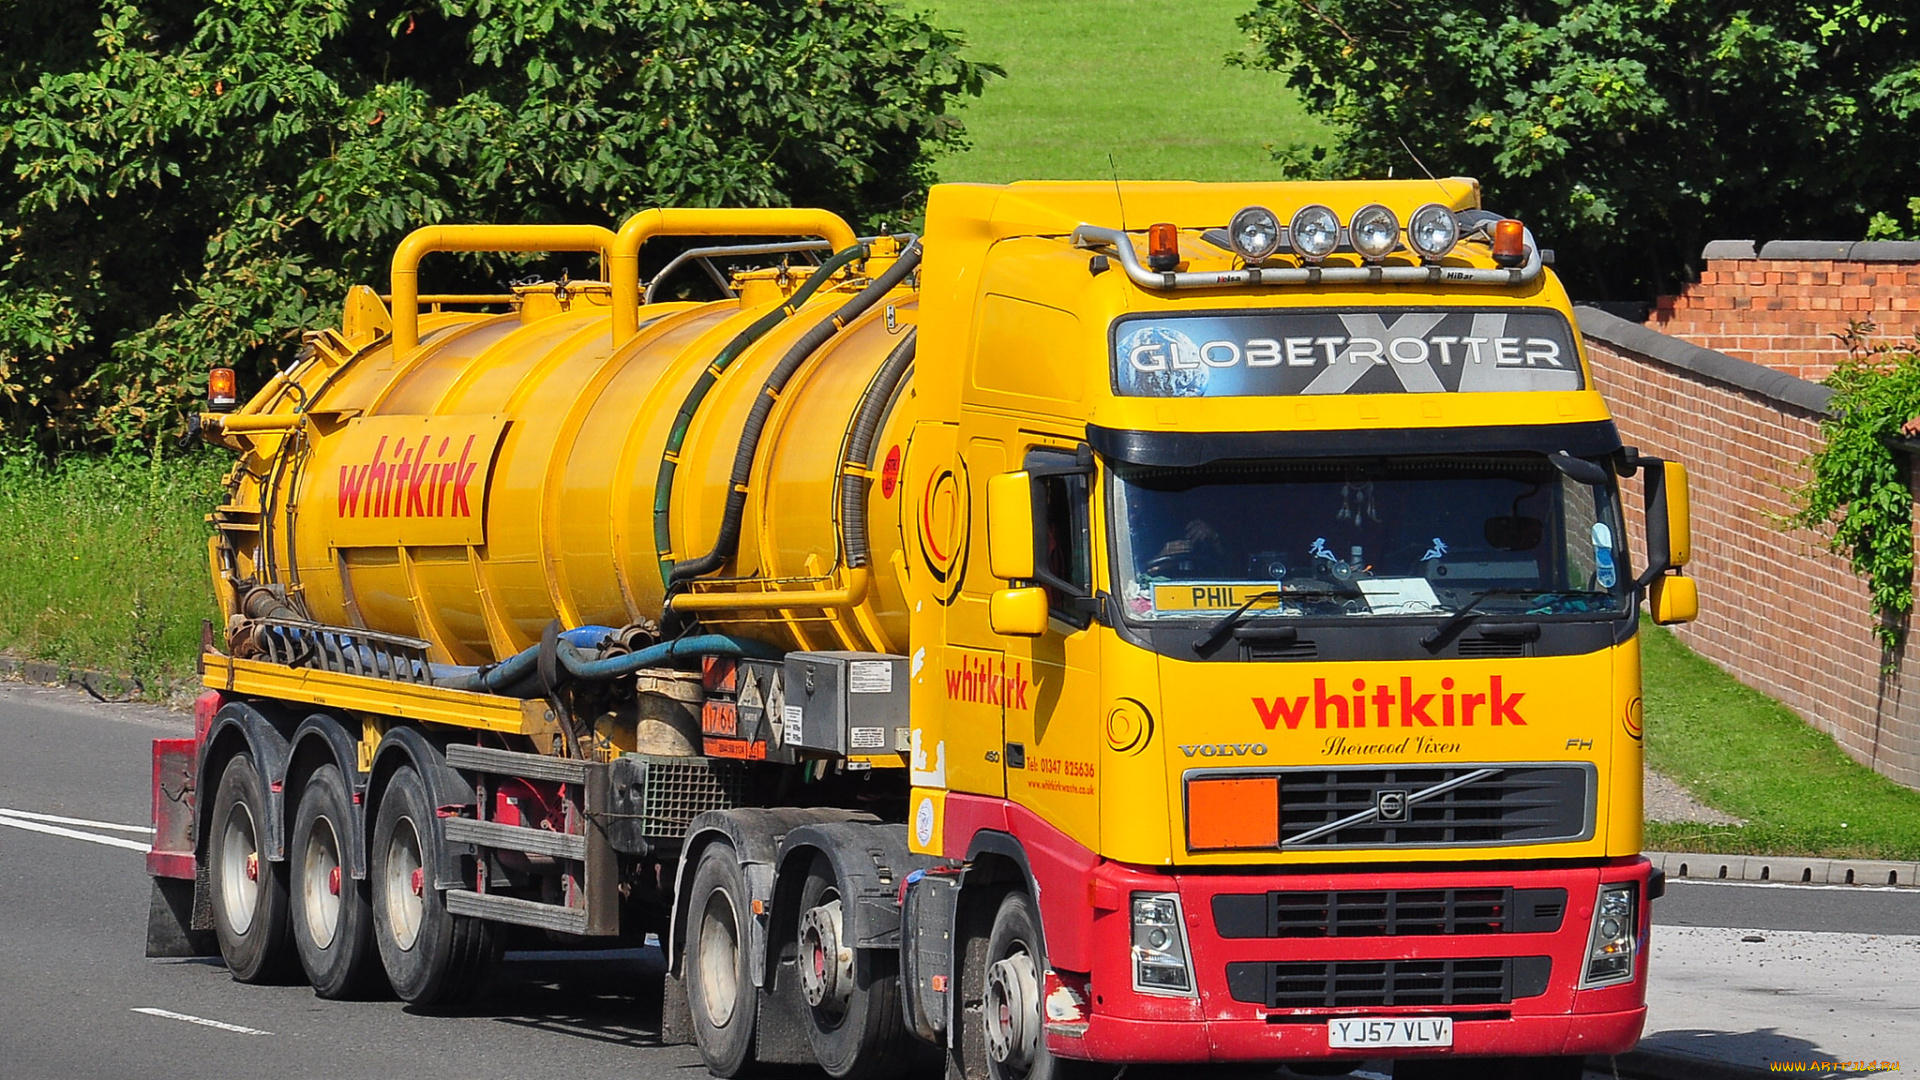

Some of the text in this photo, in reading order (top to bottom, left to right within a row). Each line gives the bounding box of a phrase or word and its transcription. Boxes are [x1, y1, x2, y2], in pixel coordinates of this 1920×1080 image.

[1447, 271, 1473, 280] HiBar
[1128, 335, 1564, 373] GLOBETROTTER
[338, 434, 478, 518] whitkirk
[1192, 587, 1242, 607] PHIL
[945, 654, 1028, 711] whitkirk
[1252, 675, 1528, 731] whitkirk
[1178, 742, 1268, 758] VOLVO
[1321, 735, 1462, 756] Sherwood Vixen
[1565, 738, 1593, 751] FH
[1041, 758, 1062, 775] 01347
[1064, 760, 1095, 778] 825636
[1339, 1020, 1443, 1042] YJ57 VLV
